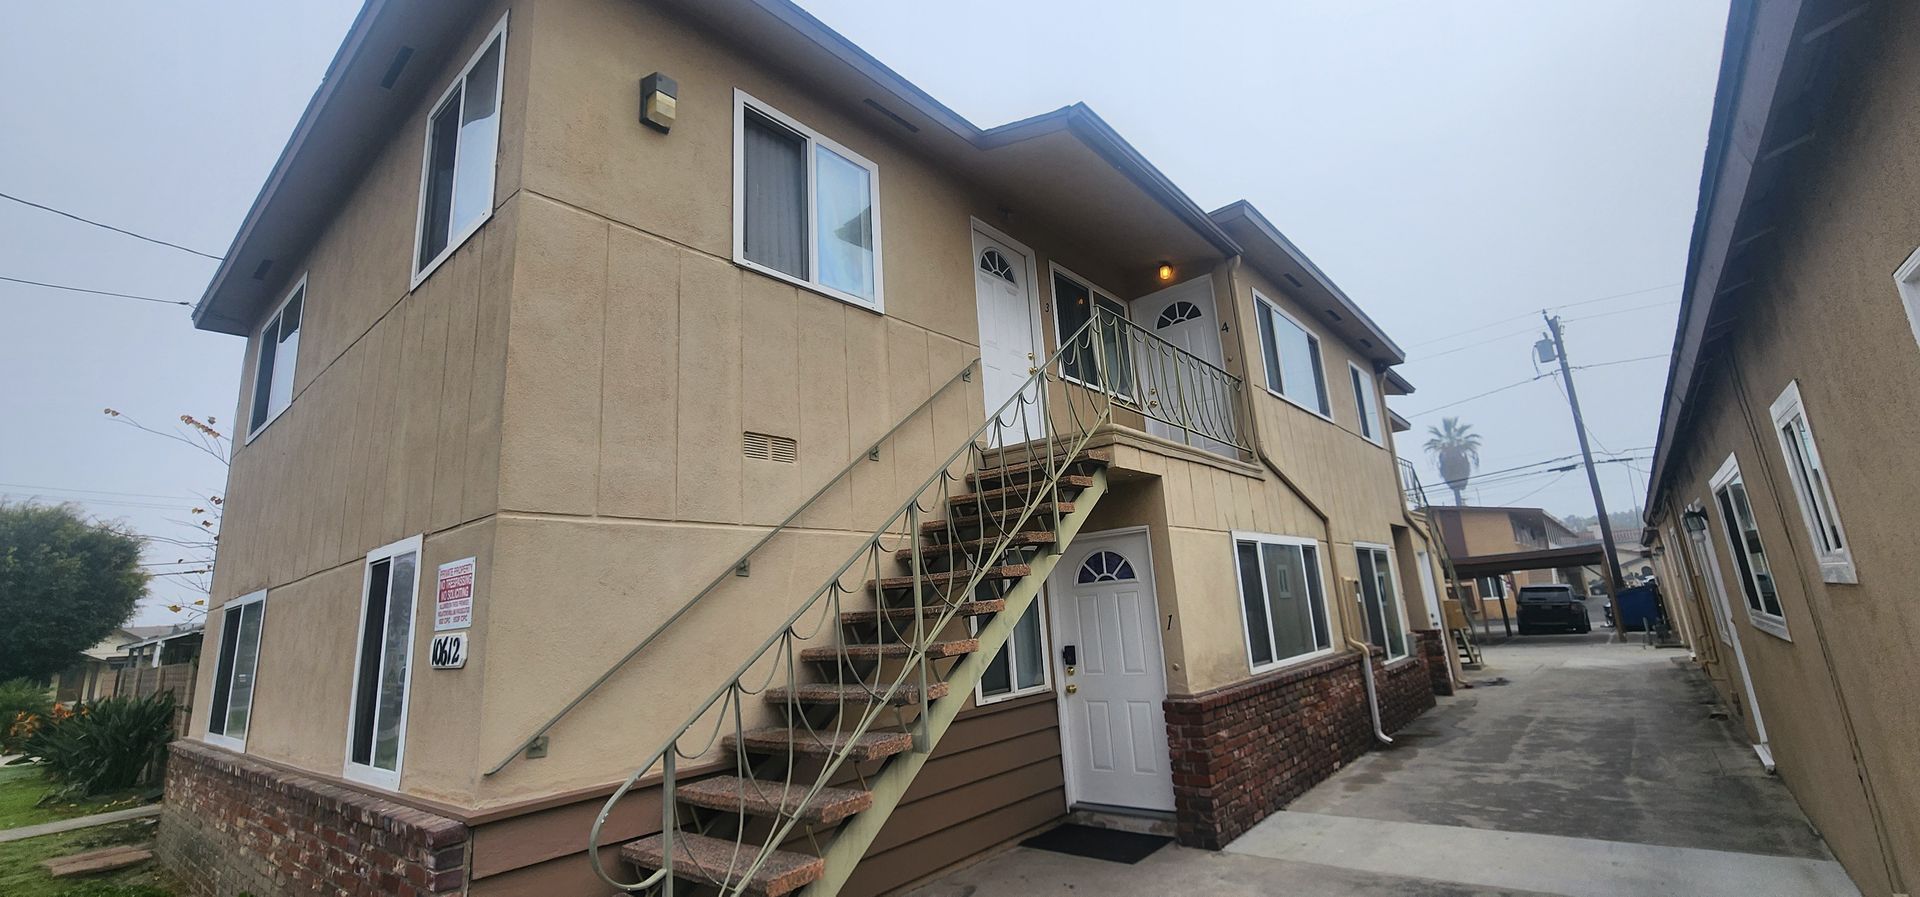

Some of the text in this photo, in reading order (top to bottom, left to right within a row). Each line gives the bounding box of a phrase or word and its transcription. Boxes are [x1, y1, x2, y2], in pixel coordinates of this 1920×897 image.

[1045, 302, 1050, 313] 3
[1221, 321, 1229, 333] 4
[446, 574, 472, 590] TRESPASSING
[440, 585, 469, 602] NO SOLICITING
[432, 636, 461, 666] 10612
